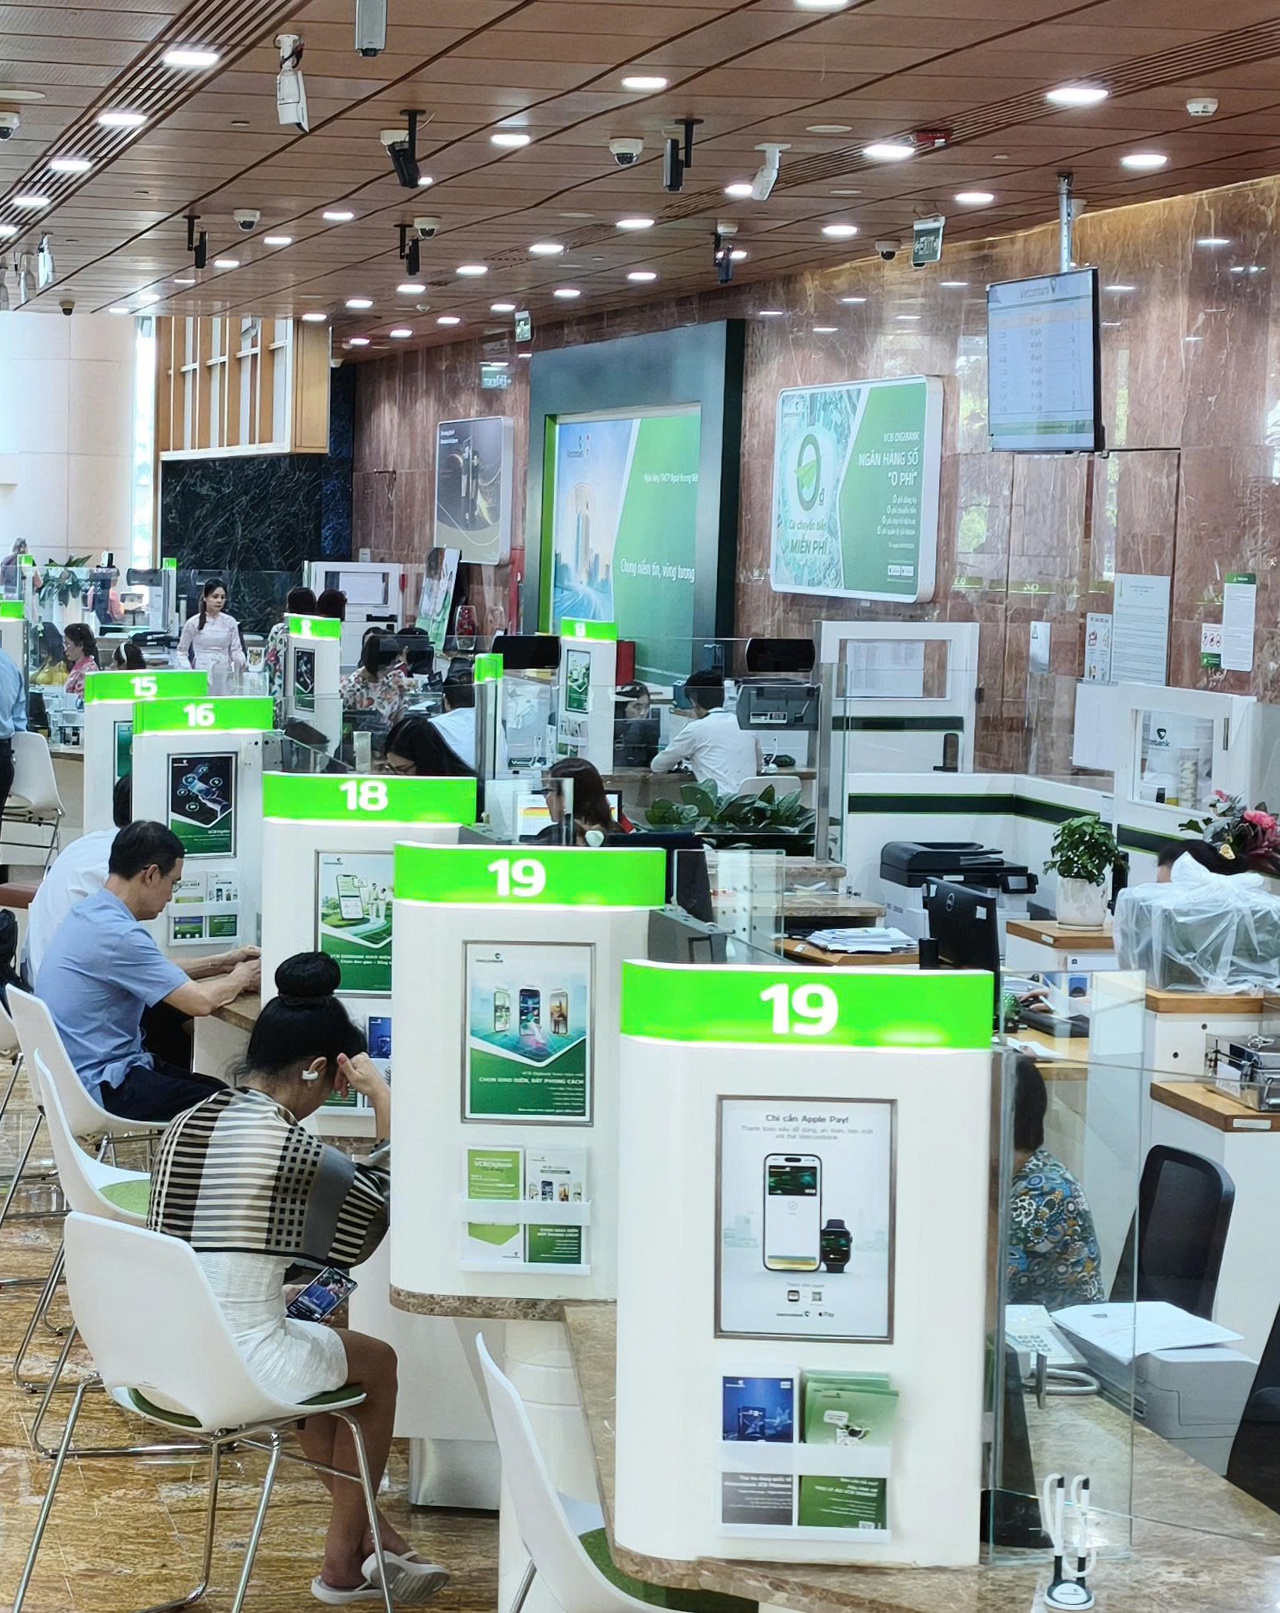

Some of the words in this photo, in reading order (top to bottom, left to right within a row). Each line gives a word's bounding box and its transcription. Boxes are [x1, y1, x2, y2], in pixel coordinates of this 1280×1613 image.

[131, 676, 157, 697] 15
[183, 703, 215, 727] 16
[339, 780, 388, 811] 18
[487, 858, 546, 897] 19
[760, 983, 839, 1036] 19
[801, 1114, 827, 1124] Apple
[829, 1115, 849, 1125] Pay!
